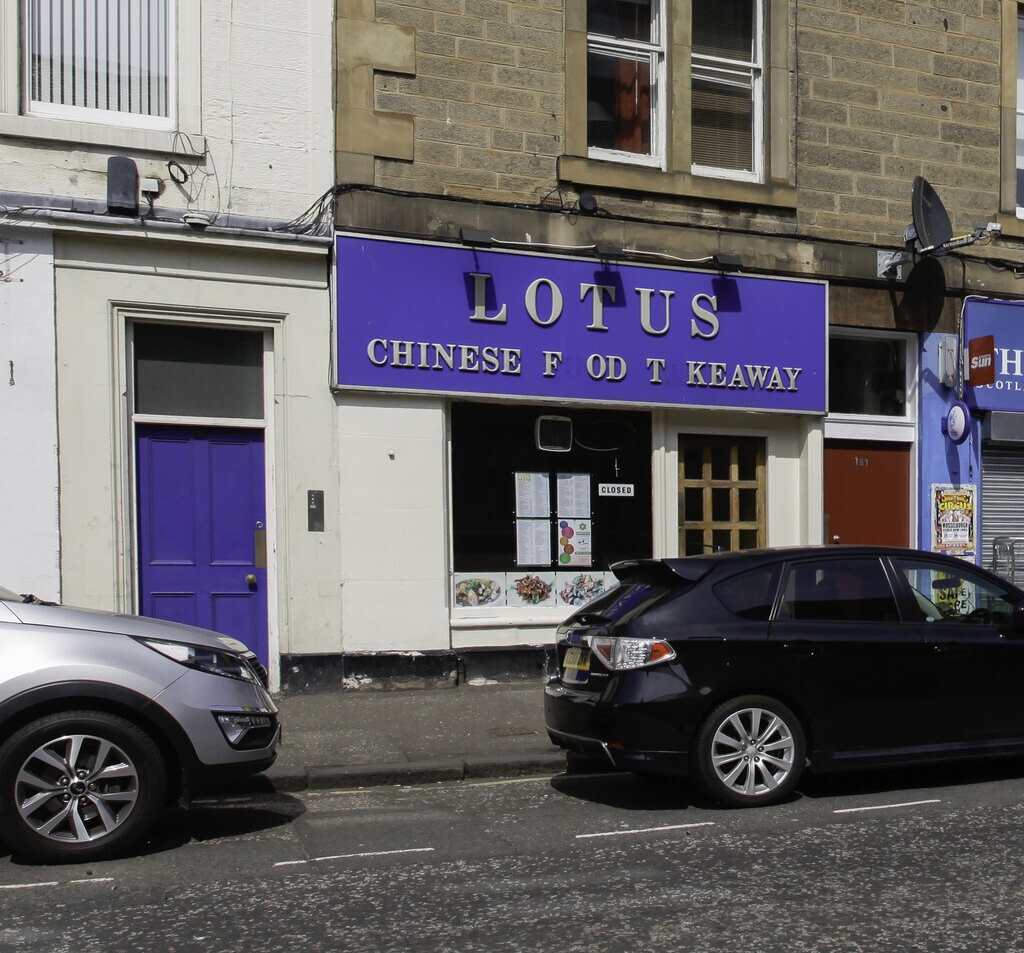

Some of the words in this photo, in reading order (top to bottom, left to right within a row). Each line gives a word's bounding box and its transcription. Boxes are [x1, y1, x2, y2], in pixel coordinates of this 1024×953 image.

[469, 272, 721, 339] LOTUS
[367, 338, 522, 375] CHINESE
[686, 360, 803, 392] KEAWAY
[854, 456, 869, 467] 181
[601, 485, 632, 494] CLOSED
[938, 501, 972, 511] CIRCUS
